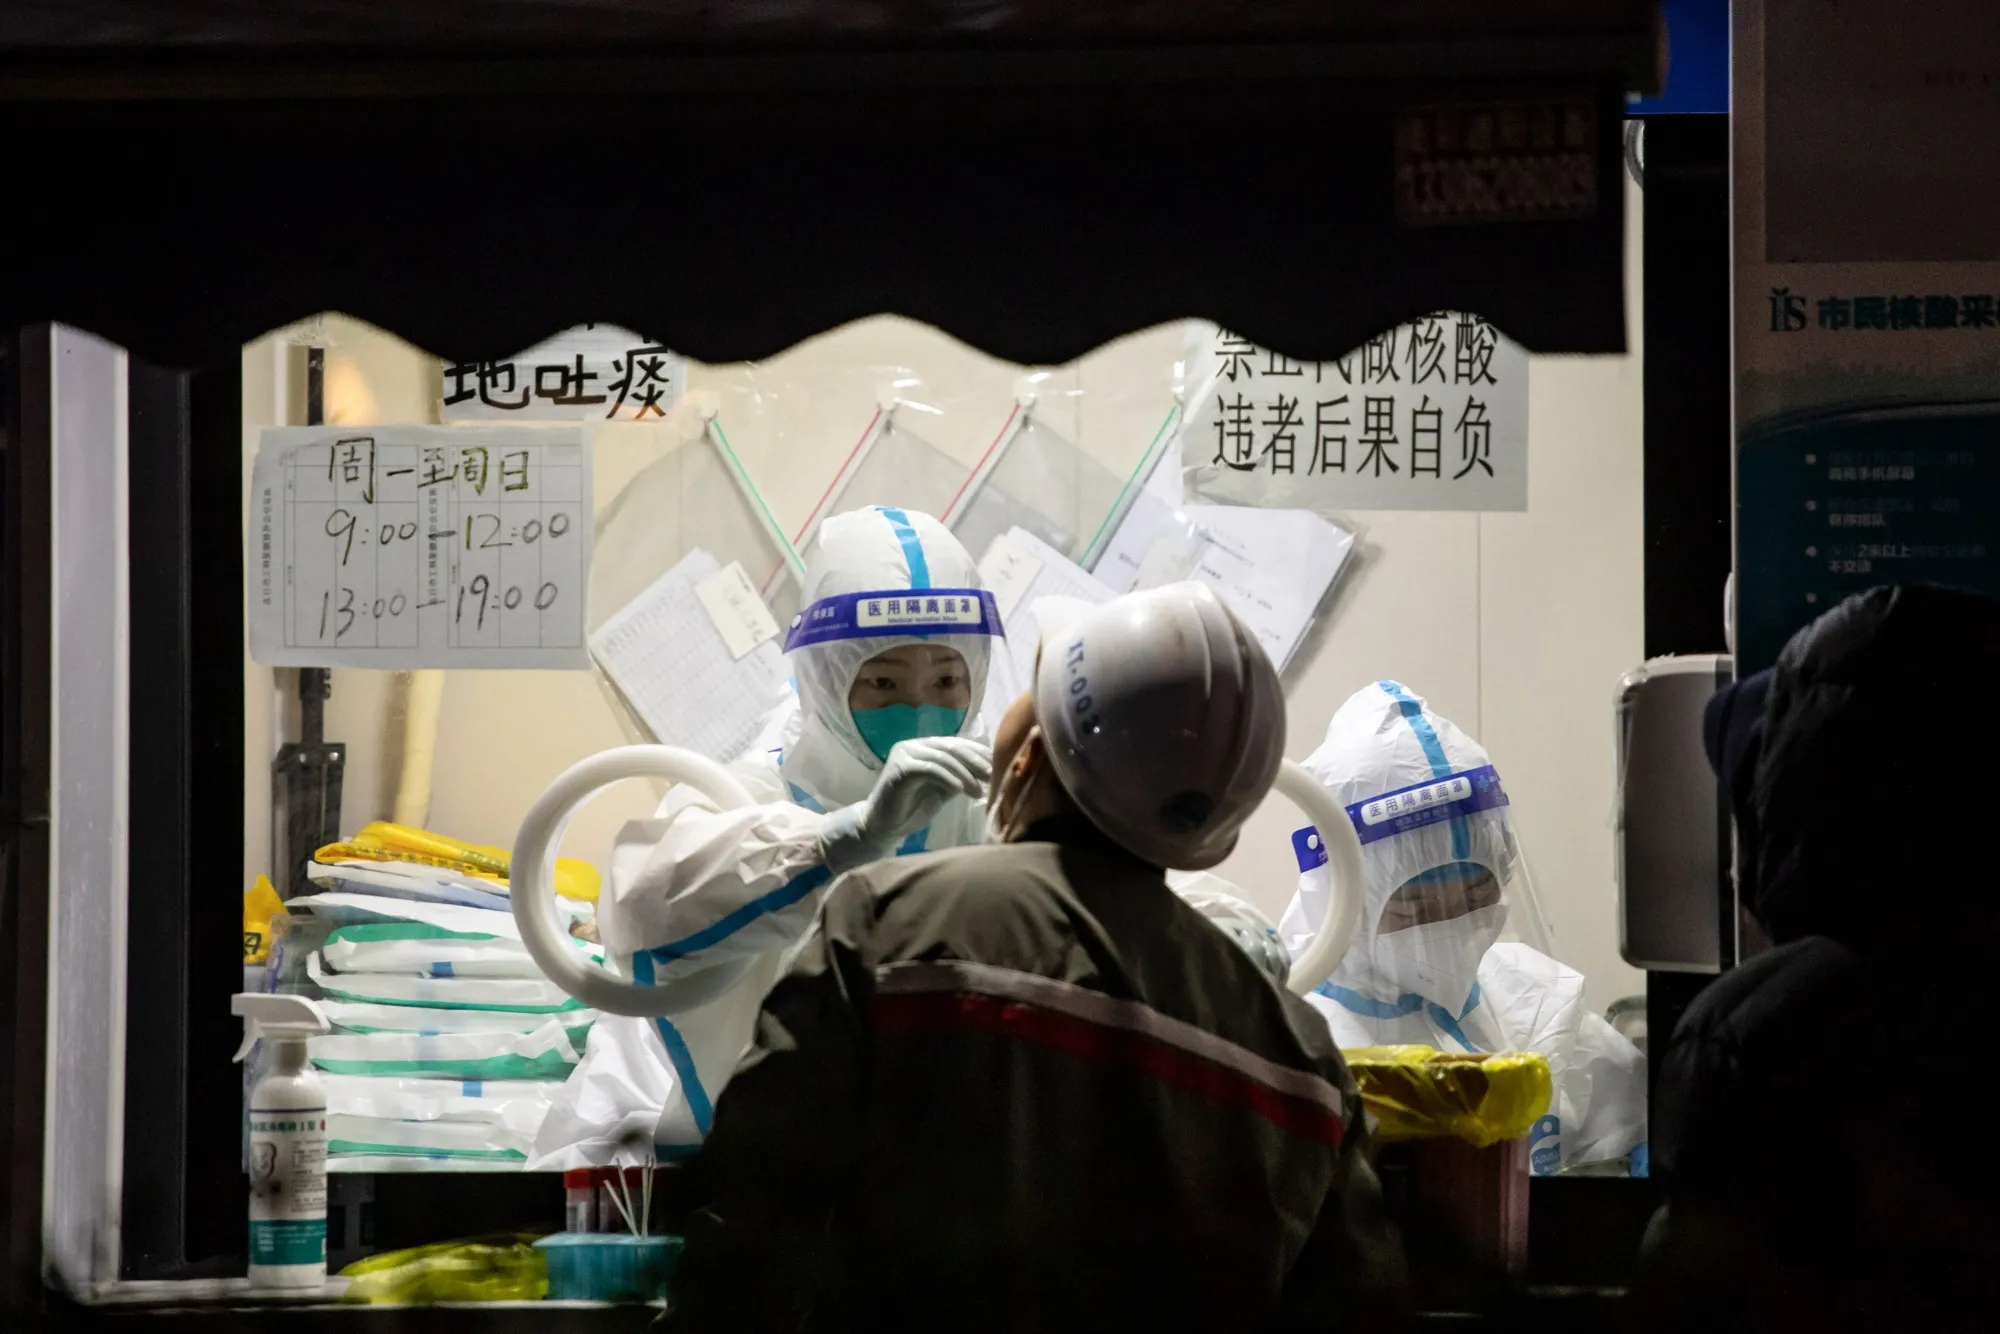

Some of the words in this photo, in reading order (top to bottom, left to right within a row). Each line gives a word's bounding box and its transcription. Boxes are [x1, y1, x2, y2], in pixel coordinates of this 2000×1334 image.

[1214, 309, 1499, 386] 禁做核酸
[1816, 294, 2000, 331] 市民核酸采
[443, 337, 670, 420] 地吐痰
[327, 437, 530, 504] 周一至周日
[1212, 391, 1496, 480] 违者后果自负
